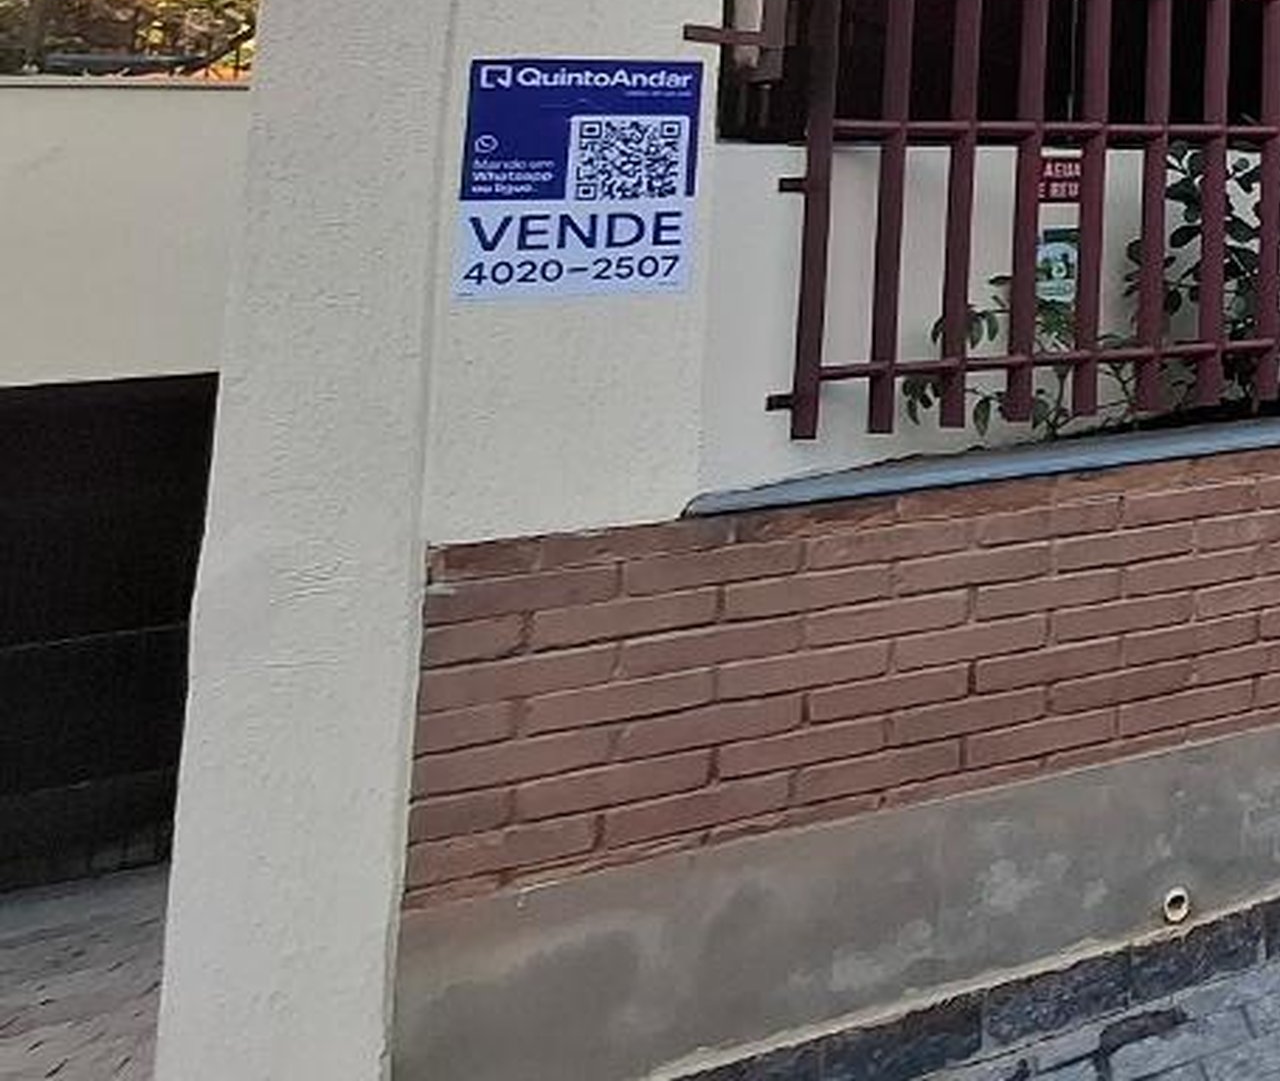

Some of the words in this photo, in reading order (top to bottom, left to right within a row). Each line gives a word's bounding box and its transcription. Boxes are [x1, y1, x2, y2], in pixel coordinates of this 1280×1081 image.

[517, 67, 692, 88] QuintoAndar
[469, 212, 682, 252] VENDE
[464, 255, 680, 285] 4020-2507
